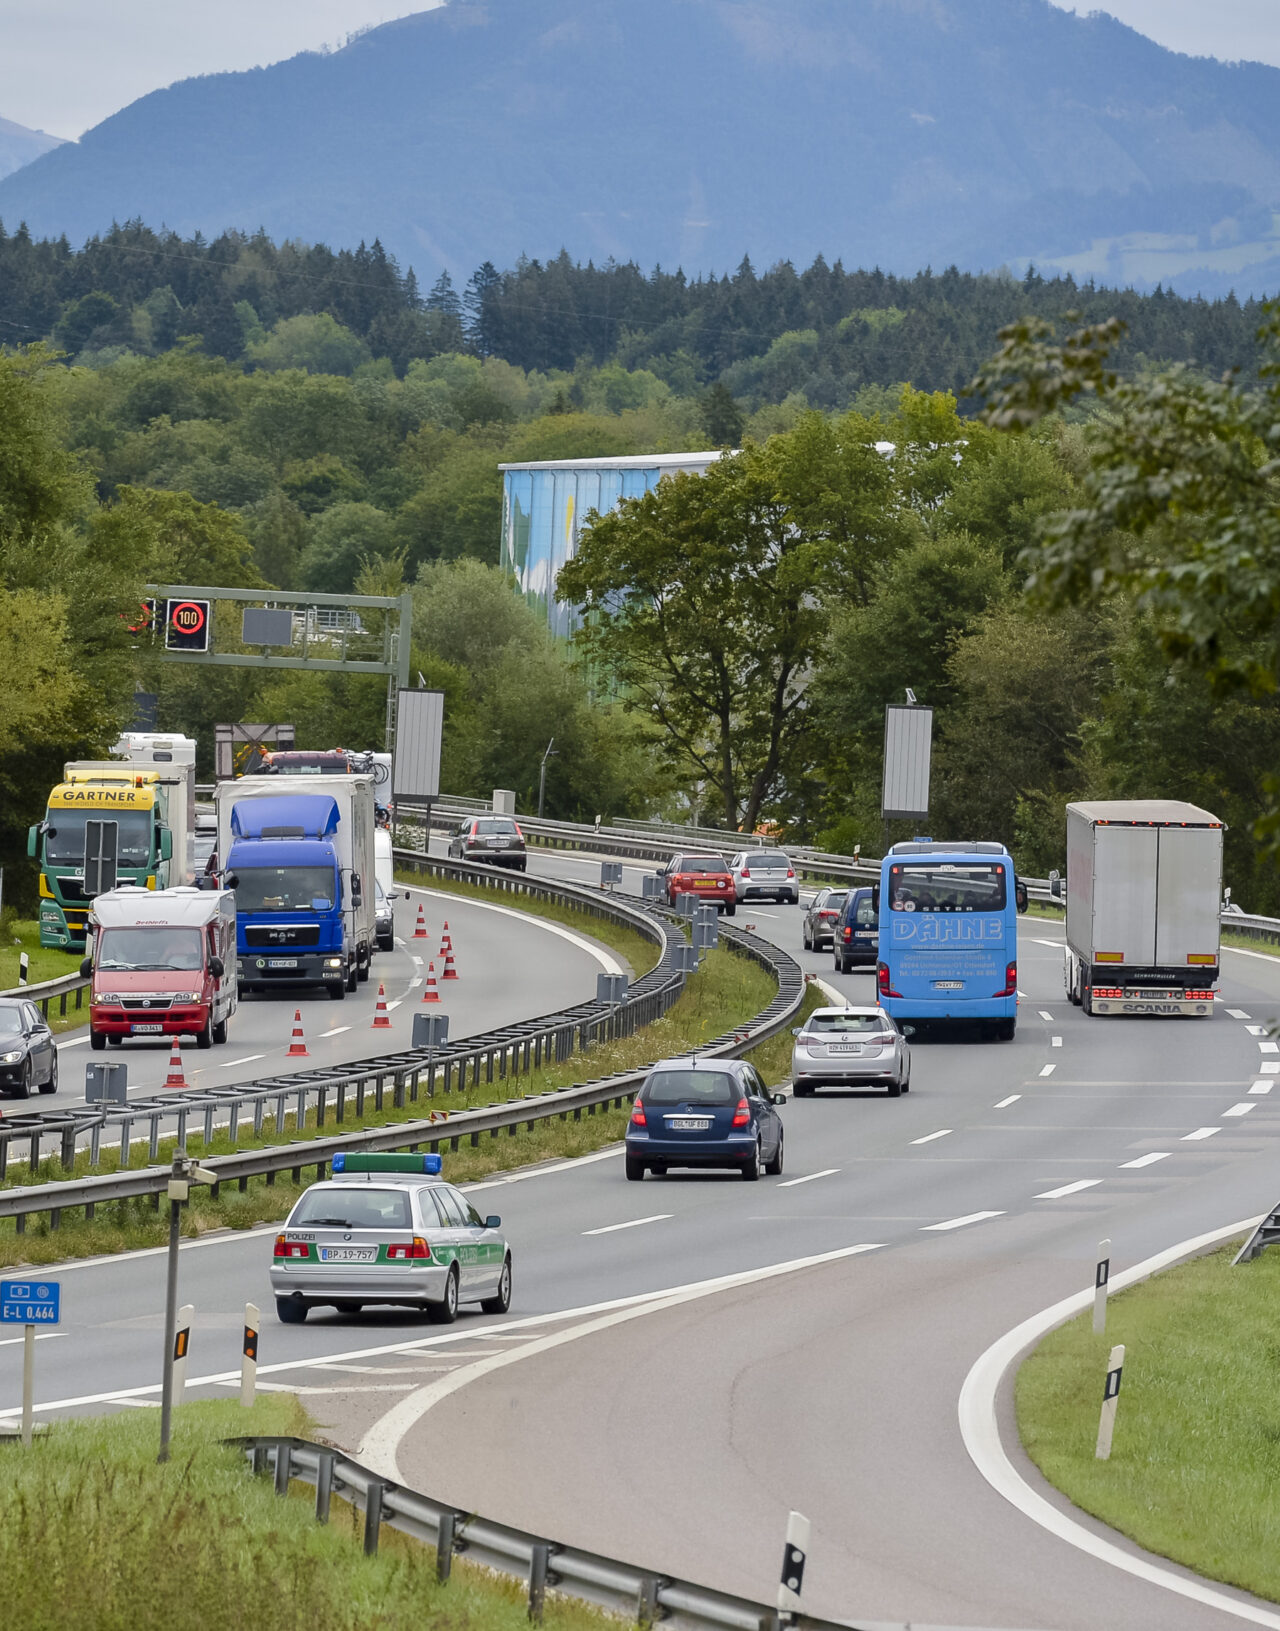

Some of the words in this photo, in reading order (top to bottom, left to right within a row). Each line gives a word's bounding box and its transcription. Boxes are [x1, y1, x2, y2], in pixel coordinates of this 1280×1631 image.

[179, 611, 198, 625] 100
[63, 791, 136, 802] GARTNER
[893, 914, 1003, 942] DÄHNE
[1122, 1004, 1182, 1013] SCANIA
[287, 1233, 316, 1241] POLIZEI
[3, 1305, 22, 1319] E-L
[26, 1306, 55, 1320] 0,464
